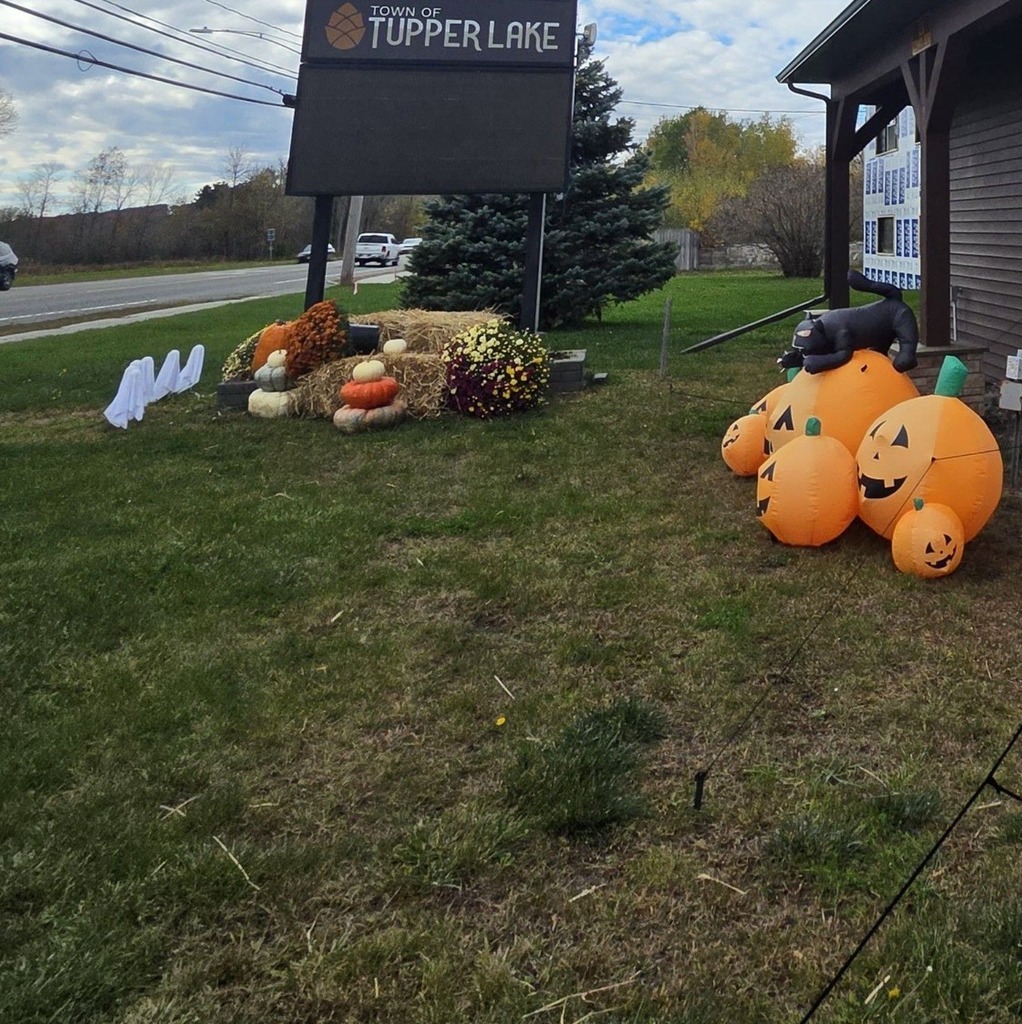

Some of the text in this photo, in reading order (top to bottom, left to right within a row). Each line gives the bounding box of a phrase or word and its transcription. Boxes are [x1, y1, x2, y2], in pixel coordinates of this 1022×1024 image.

[370, 5, 442, 18] TOWN OF
[368, 17, 560, 53] TUPPER LAKE
